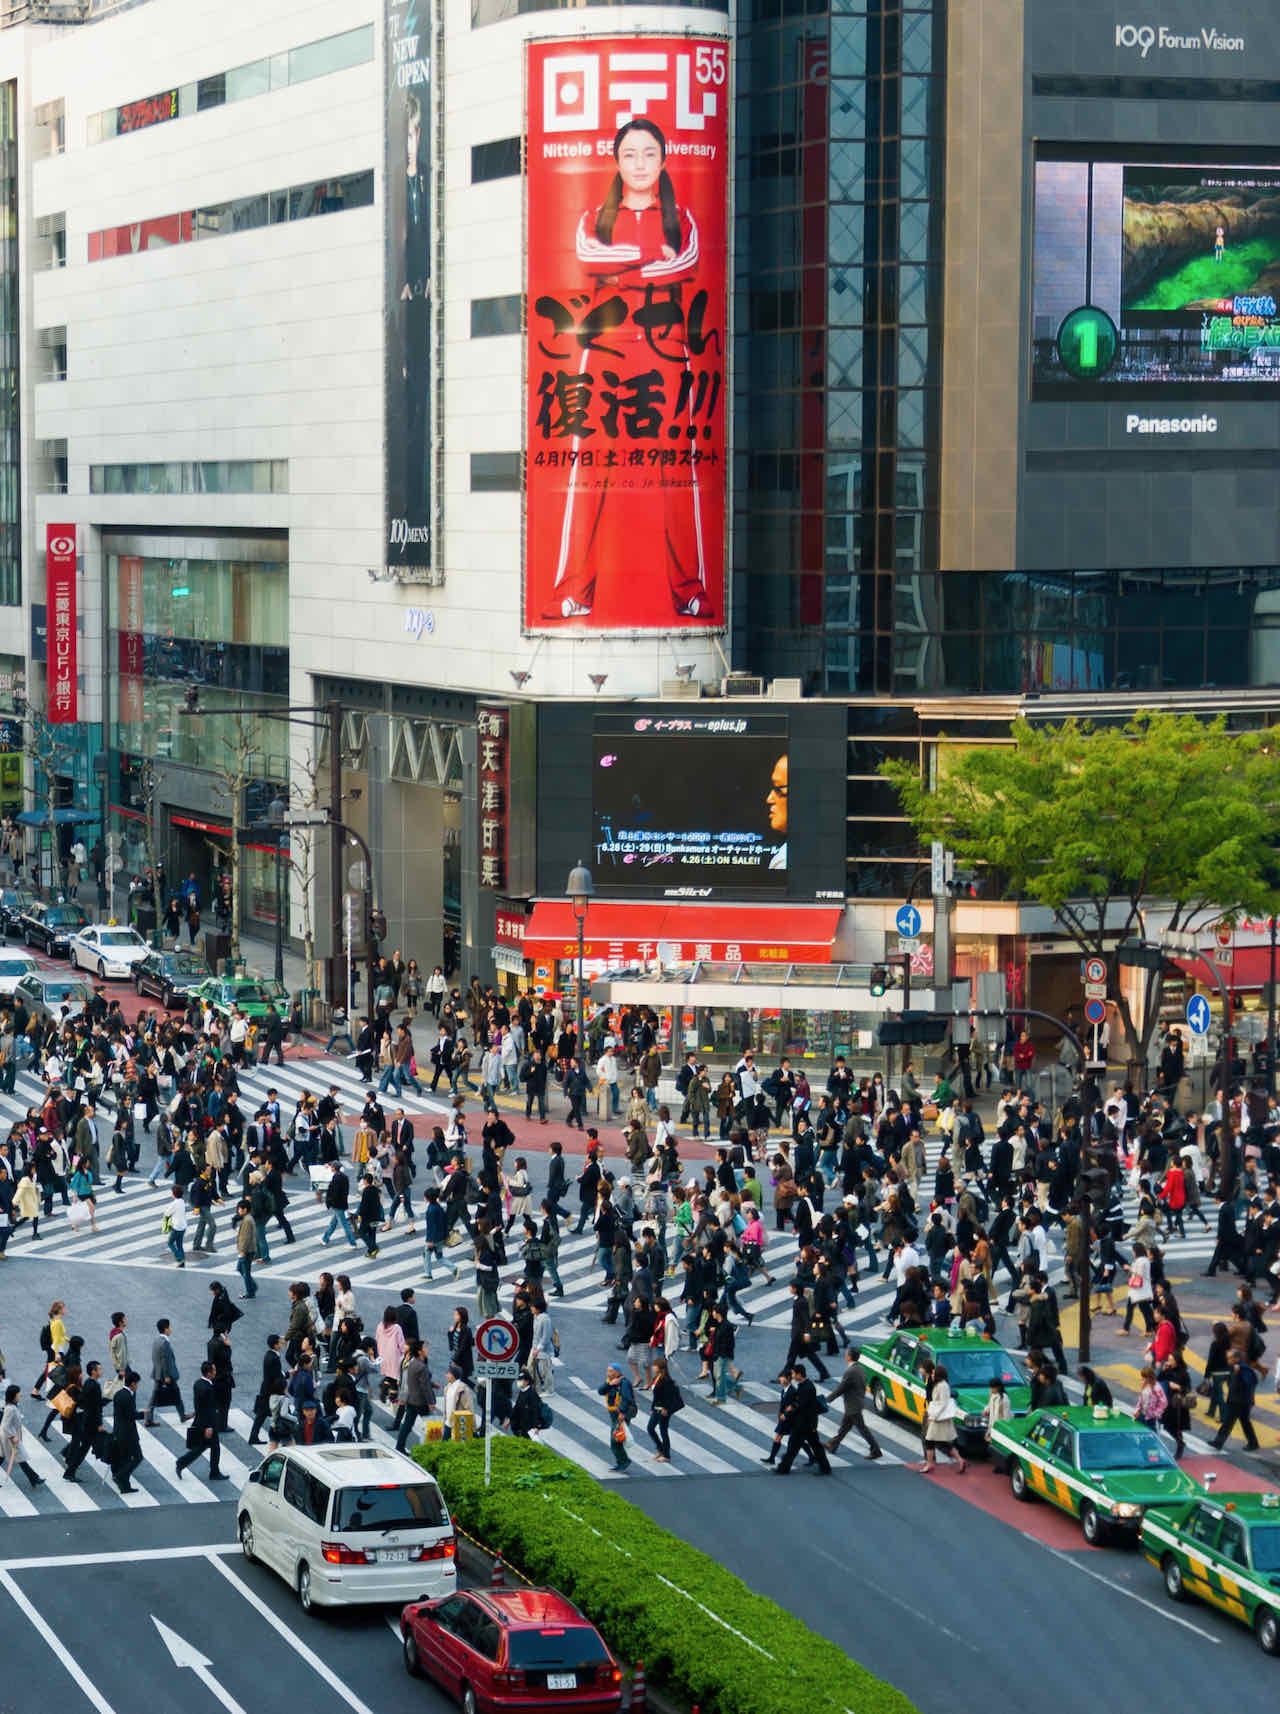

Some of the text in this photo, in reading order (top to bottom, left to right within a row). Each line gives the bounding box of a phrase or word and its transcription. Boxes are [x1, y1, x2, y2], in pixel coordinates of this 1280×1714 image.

[392, 35, 419, 64] NEW
[1114, 24, 1245, 58] 109 Forum Vision
[398, 58, 430, 89] OPEN
[696, 47, 725, 84] 55
[543, 53, 717, 133] 日テレ
[543, 142, 593, 158] Nittele
[664, 142, 717, 160] niversary
[535, 289, 722, 363] ごくせん
[1072, 319, 1098, 368] 1
[1126, 413, 1218, 433] Panasonic
[55, 581, 71, 711] 三菱東京UFJ銀行
[654, 719, 692, 731] イープラス
[707, 718, 748, 733] eplus.jp
[717, 855, 730, 864] ON
[477, 1365, 517, 1376] ここから
